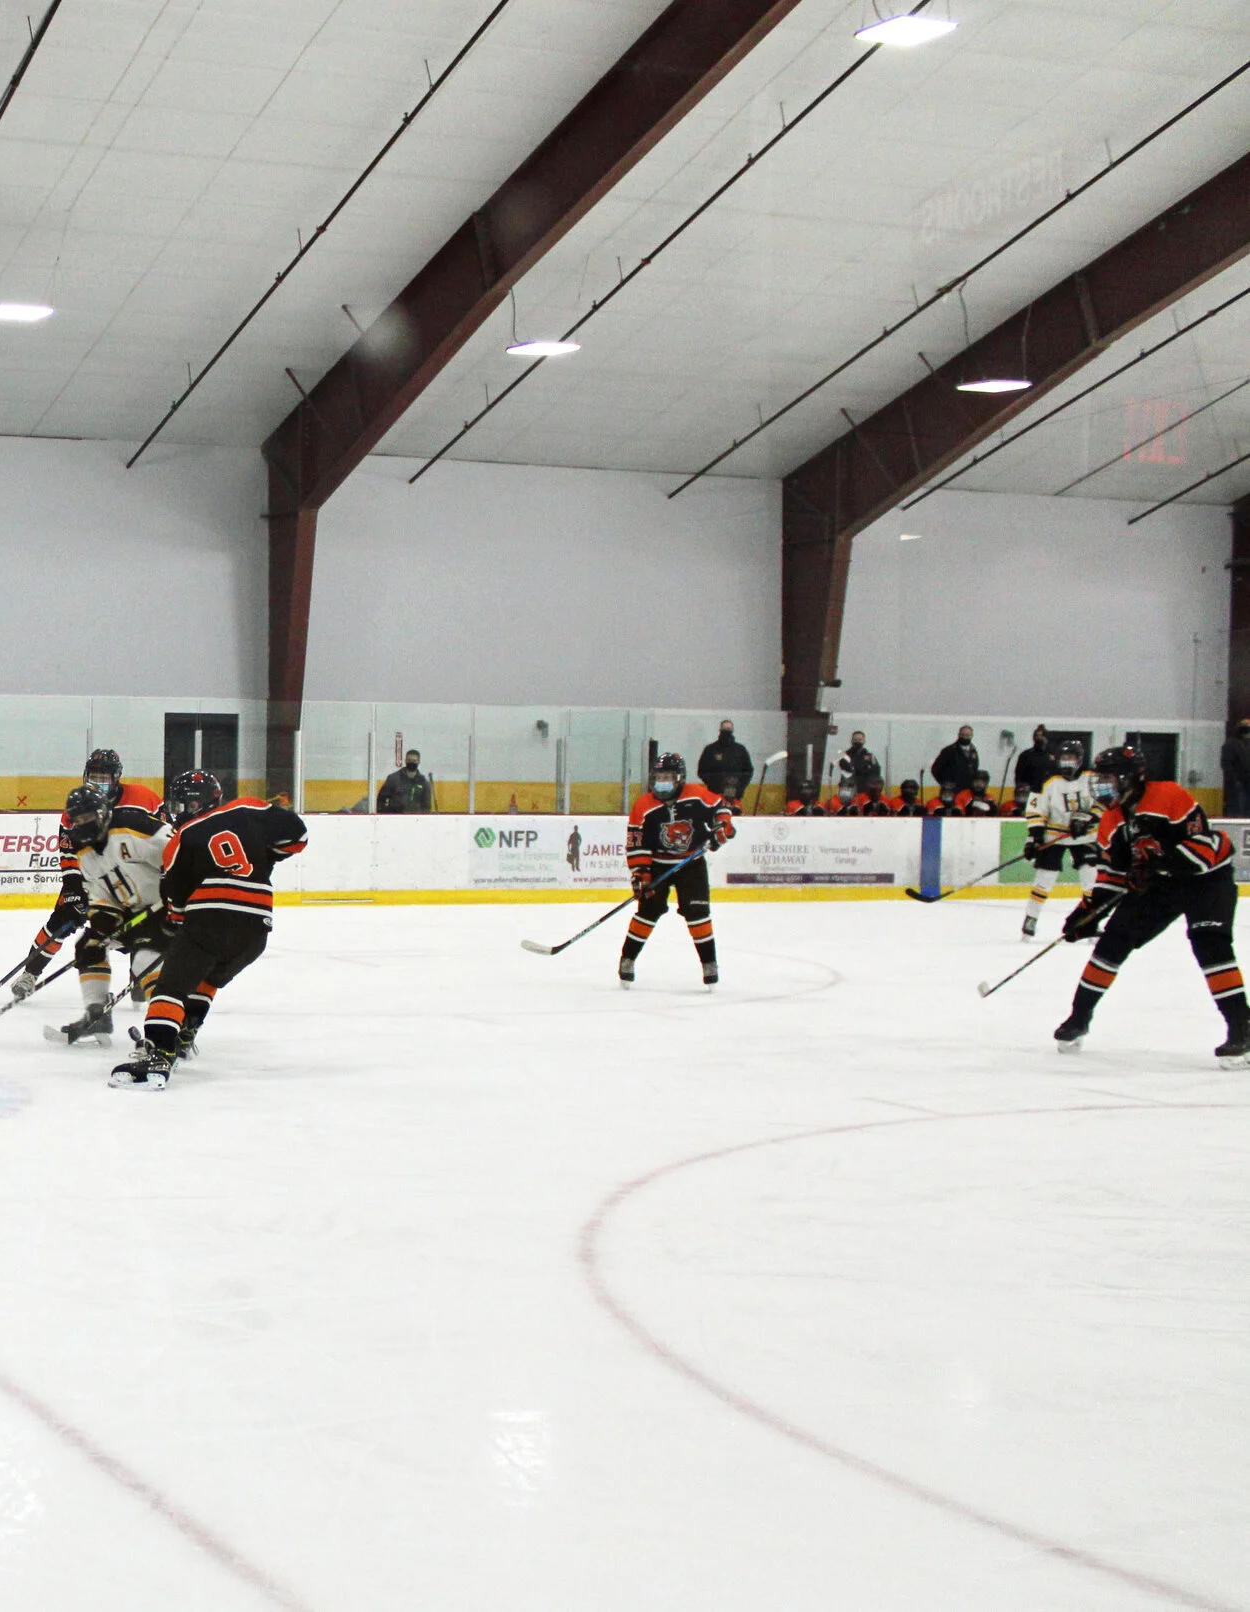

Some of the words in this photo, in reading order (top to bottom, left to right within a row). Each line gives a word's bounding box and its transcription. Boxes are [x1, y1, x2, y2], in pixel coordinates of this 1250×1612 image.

[499, 830, 538, 848] NFP
[120, 842, 131, 860] A
[208, 830, 254, 877] 9
[583, 844, 628, 856] JAMIE
[751, 844, 810, 854] BERKSHIRE
[29, 853, 61, 867] Fue
[752, 855, 806, 865] HATHAWAY
